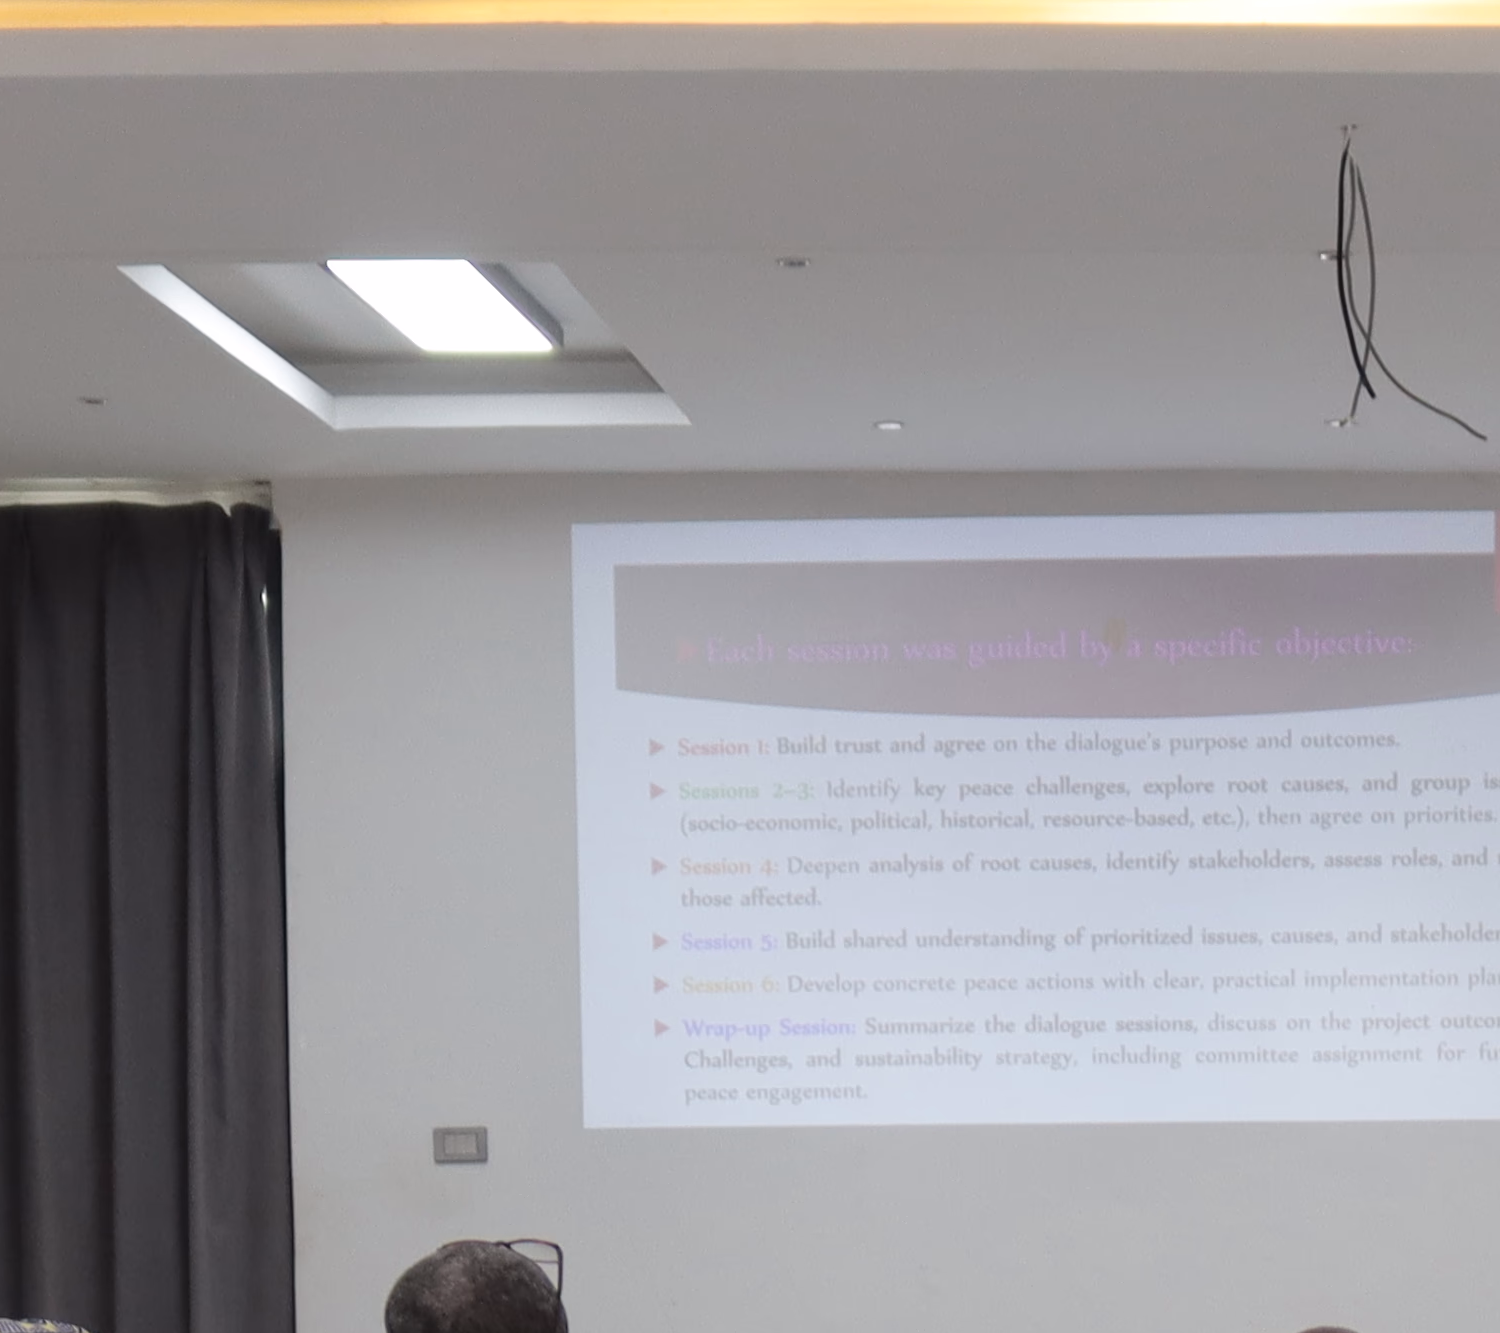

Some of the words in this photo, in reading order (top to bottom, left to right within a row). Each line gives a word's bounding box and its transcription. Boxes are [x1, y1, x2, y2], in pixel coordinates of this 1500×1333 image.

[707, 633, 776, 663] Each
[788, 641, 891, 663] session
[902, 640, 959, 662] was
[967, 629, 1069, 669] guided
[1078, 630, 1111, 667] by
[1153, 627, 1261, 666] specific
[1276, 625, 1413, 663] objective:
[777, 733, 827, 756] Build
[834, 739, 882, 755] trust
[890, 731, 925, 754] and
[934, 738, 986, 759] agree
[993, 739, 1018, 752] on
[1026, 731, 1057, 753] the
[1169, 736, 1248, 757] purpose
[1256, 728, 1292, 749] and
[1301, 733, 1400, 749] outcomes.
[827, 777, 900, 803] Identify
[913, 776, 946, 803] key
[959, 783, 1013, 803] peace
[1025, 774, 1130, 801] challenges,
[1143, 773, 1215, 800] explore
[1227, 777, 1268, 794] root
[1281, 778, 1349, 794] causes,
[1362, 770, 1398, 792] and
[1411, 776, 1471, 798] group
[851, 808, 932, 836] political,
[940, 807, 1034, 830] historical,
[1258, 804, 1301, 826] then
[1310, 811, 1362, 832] agree
[1371, 810, 1395, 824] on
[1404, 804, 1497, 830] priorities.
[787, 855, 860, 880] Deepen
[869, 852, 944, 878] analysis
[952, 852, 974, 873] of
[981, 856, 1021, 872] root
[1029, 857, 1097, 873] causes,
[1106, 848, 1180, 876] identify
[1188, 847, 1315, 870] stakeholders,
[1324, 854, 1382, 869] assess
[1392, 846, 1443, 870] roles,
[1452, 845, 1488, 867] and
[681, 886, 733, 908] those
[740, 885, 822, 908] affected.
[681, 932, 754, 952] Session
[786, 928, 835, 950] Build
[843, 928, 907, 949] shared
[915, 926, 1056, 952] understanding
[1064, 925, 1086, 947] of
[1091, 924, 1193, 953] prioritized
[1201, 927, 1263, 946] issues,
[1271, 931, 1338, 946] causes,
[1346, 922, 1382, 944] and
[779, 1017, 857, 1037] Session:
[865, 1016, 975, 1036] Summarize
[984, 1013, 1015, 1034] the
[1025, 1012, 1106, 1039] dialogue
[1116, 1014, 1198, 1034] sessions,
[1208, 1011, 1276, 1032] discuss
[1286, 1017, 1310, 1031] on
[1321, 1010, 1351, 1031] the
[1362, 1006, 1430, 1036] project
